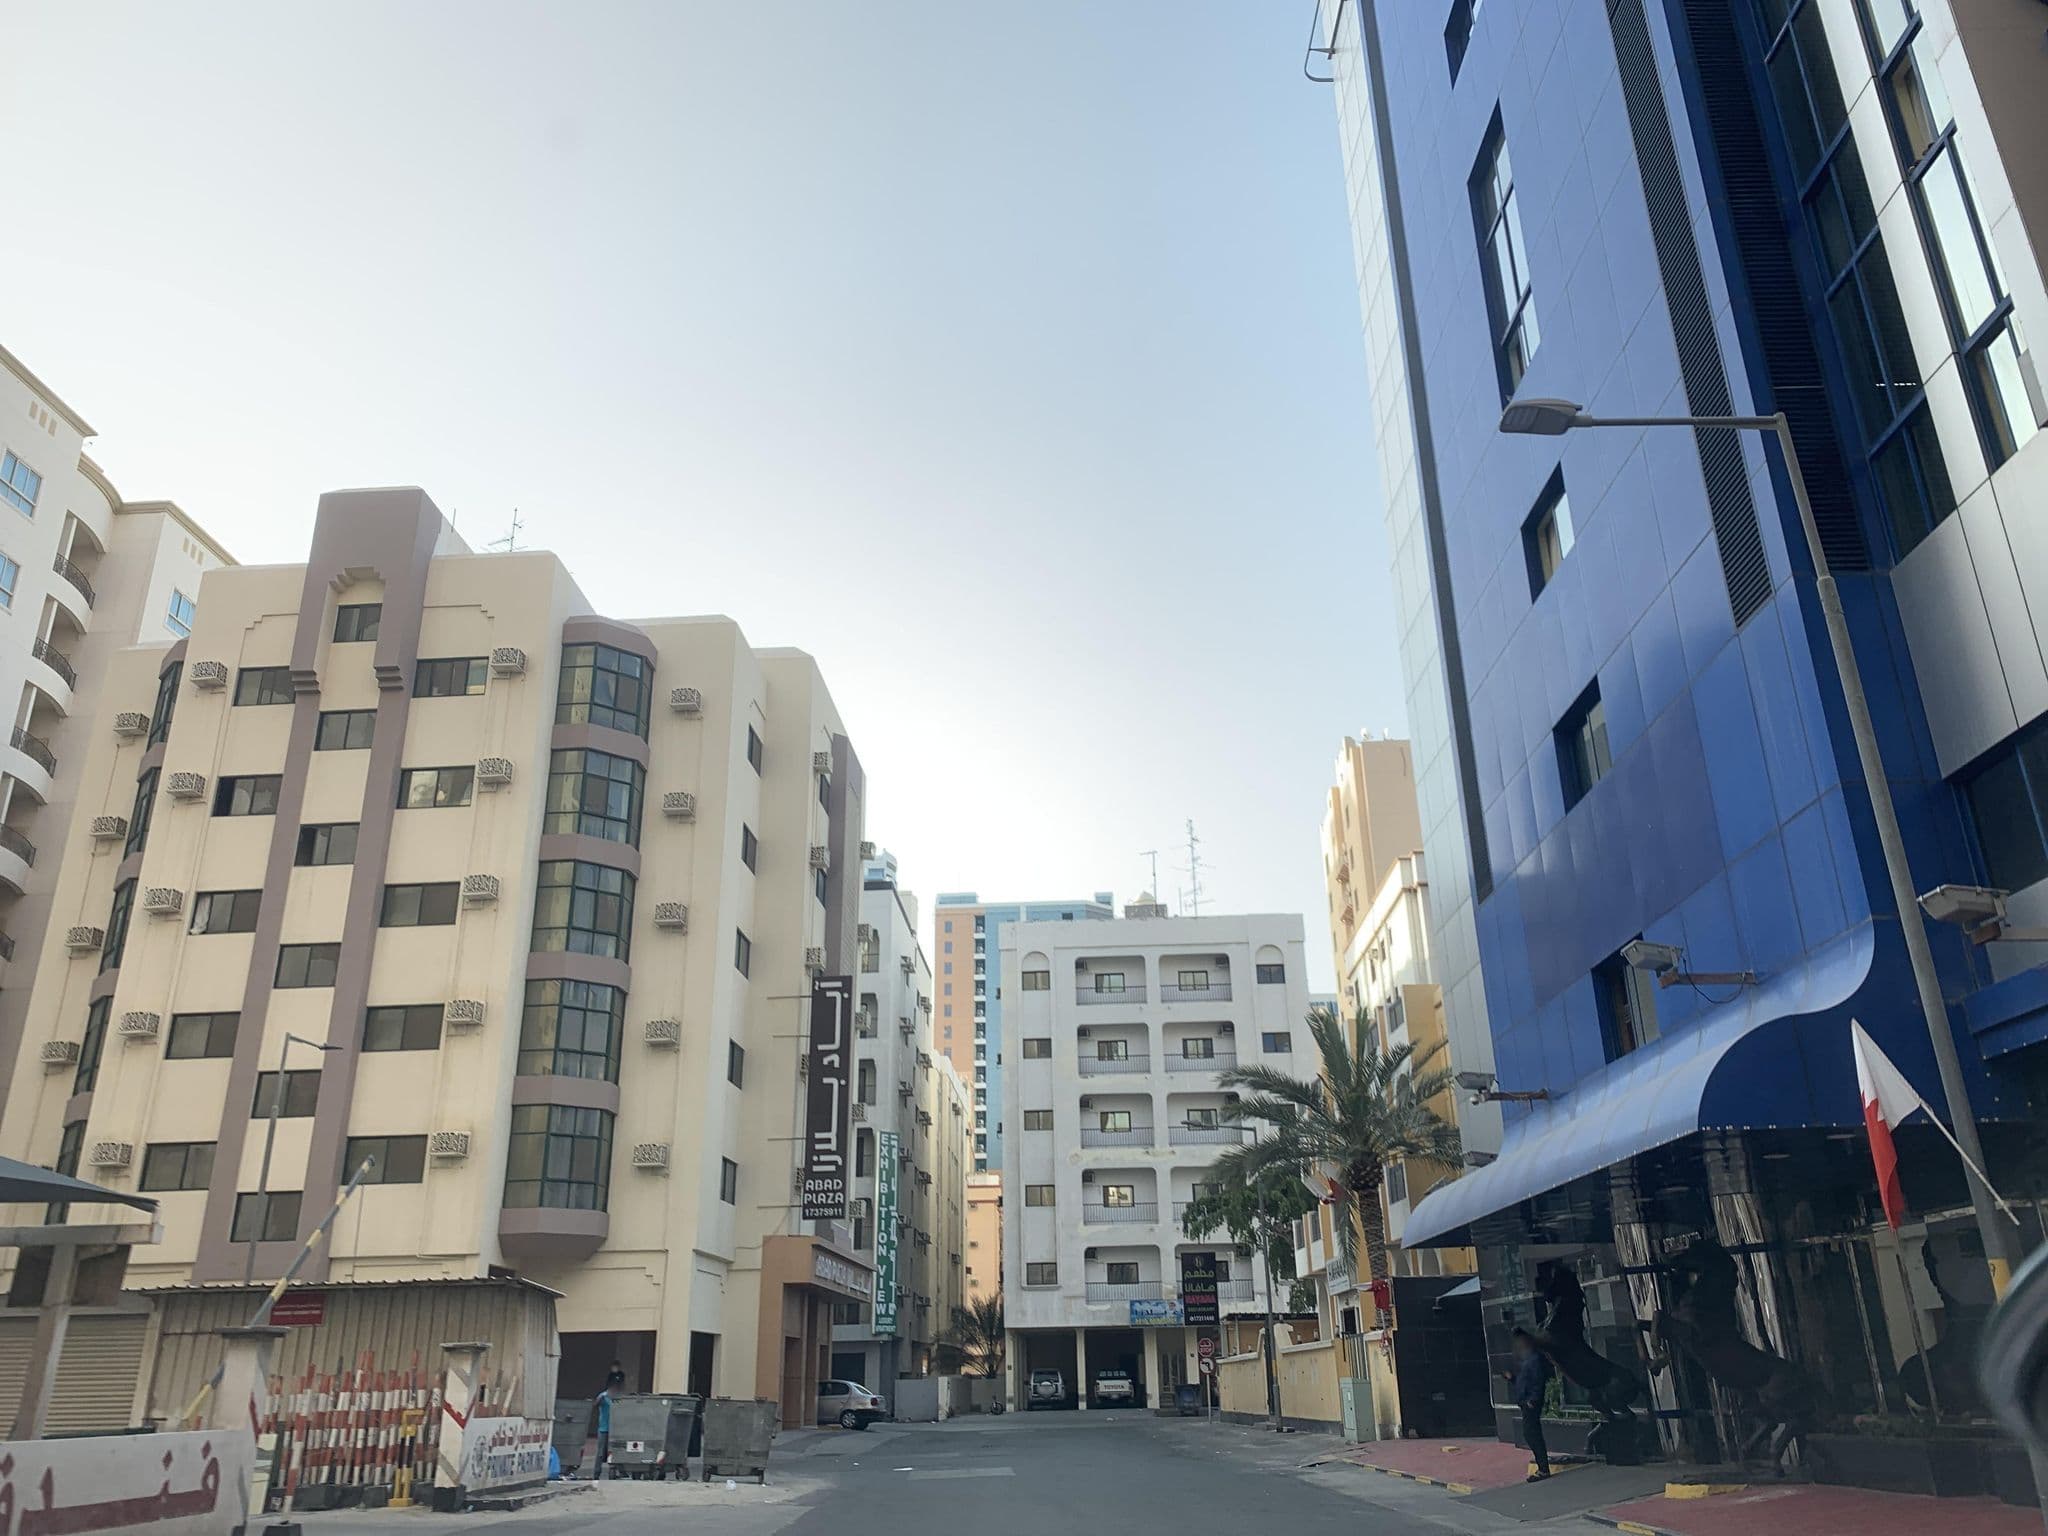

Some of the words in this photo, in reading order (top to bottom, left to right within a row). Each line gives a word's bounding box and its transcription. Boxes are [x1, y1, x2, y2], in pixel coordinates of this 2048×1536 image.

[812, 1077, 846, 1172] بلازا
[805, 1179, 843, 1191] ABAD
[804, 1192, 844, 1205] PLAZA
[878, 1134, 889, 1257] EXHIBITION
[805, 1208, 842, 1217] 17375911
[1184, 1268, 1215, 1280] مطعم
[876, 1264, 887, 1316] VIEW
